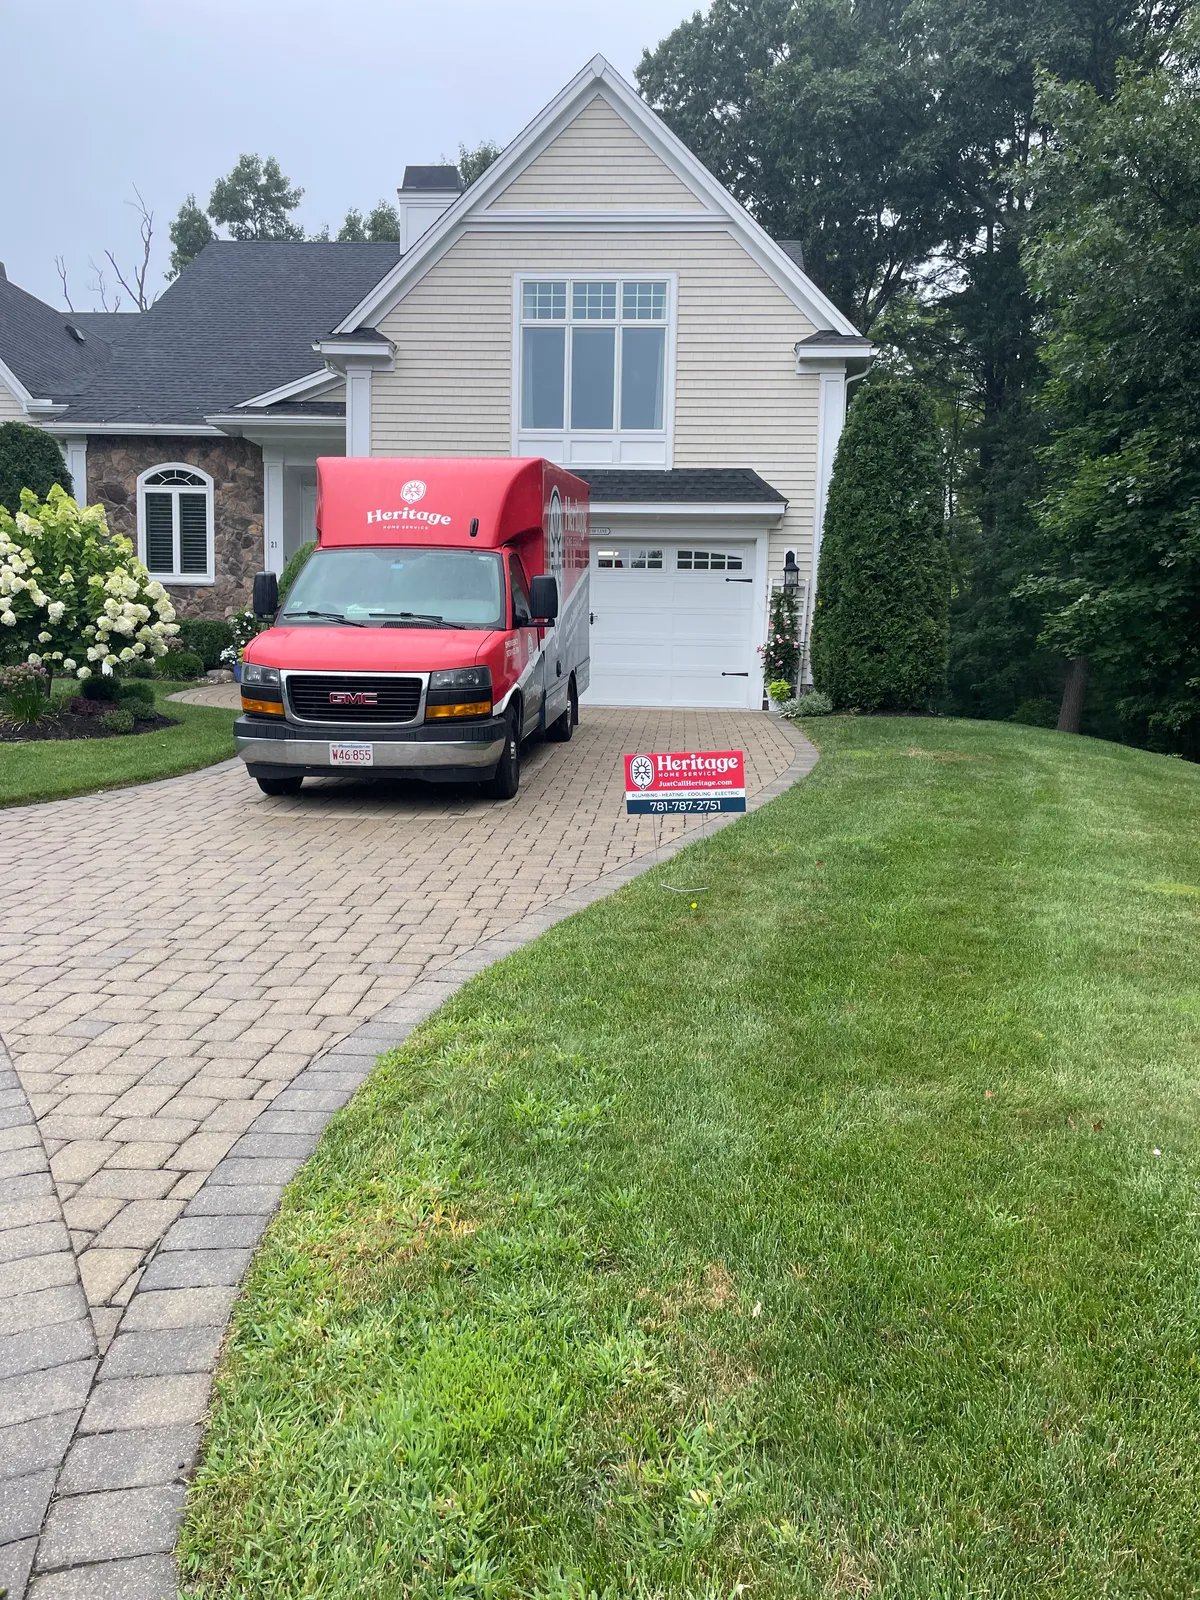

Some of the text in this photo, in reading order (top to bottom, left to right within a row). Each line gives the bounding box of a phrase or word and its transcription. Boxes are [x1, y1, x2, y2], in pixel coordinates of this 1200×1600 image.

[366, 506, 452, 526] Heritage
[270, 541, 278, 549] 21
[329, 691, 378, 705] GMC
[656, 753, 739, 773] Heritage
[658, 779, 733, 787] JustCallHeritage.com
[649, 800, 721, 812] 781-787-2751
